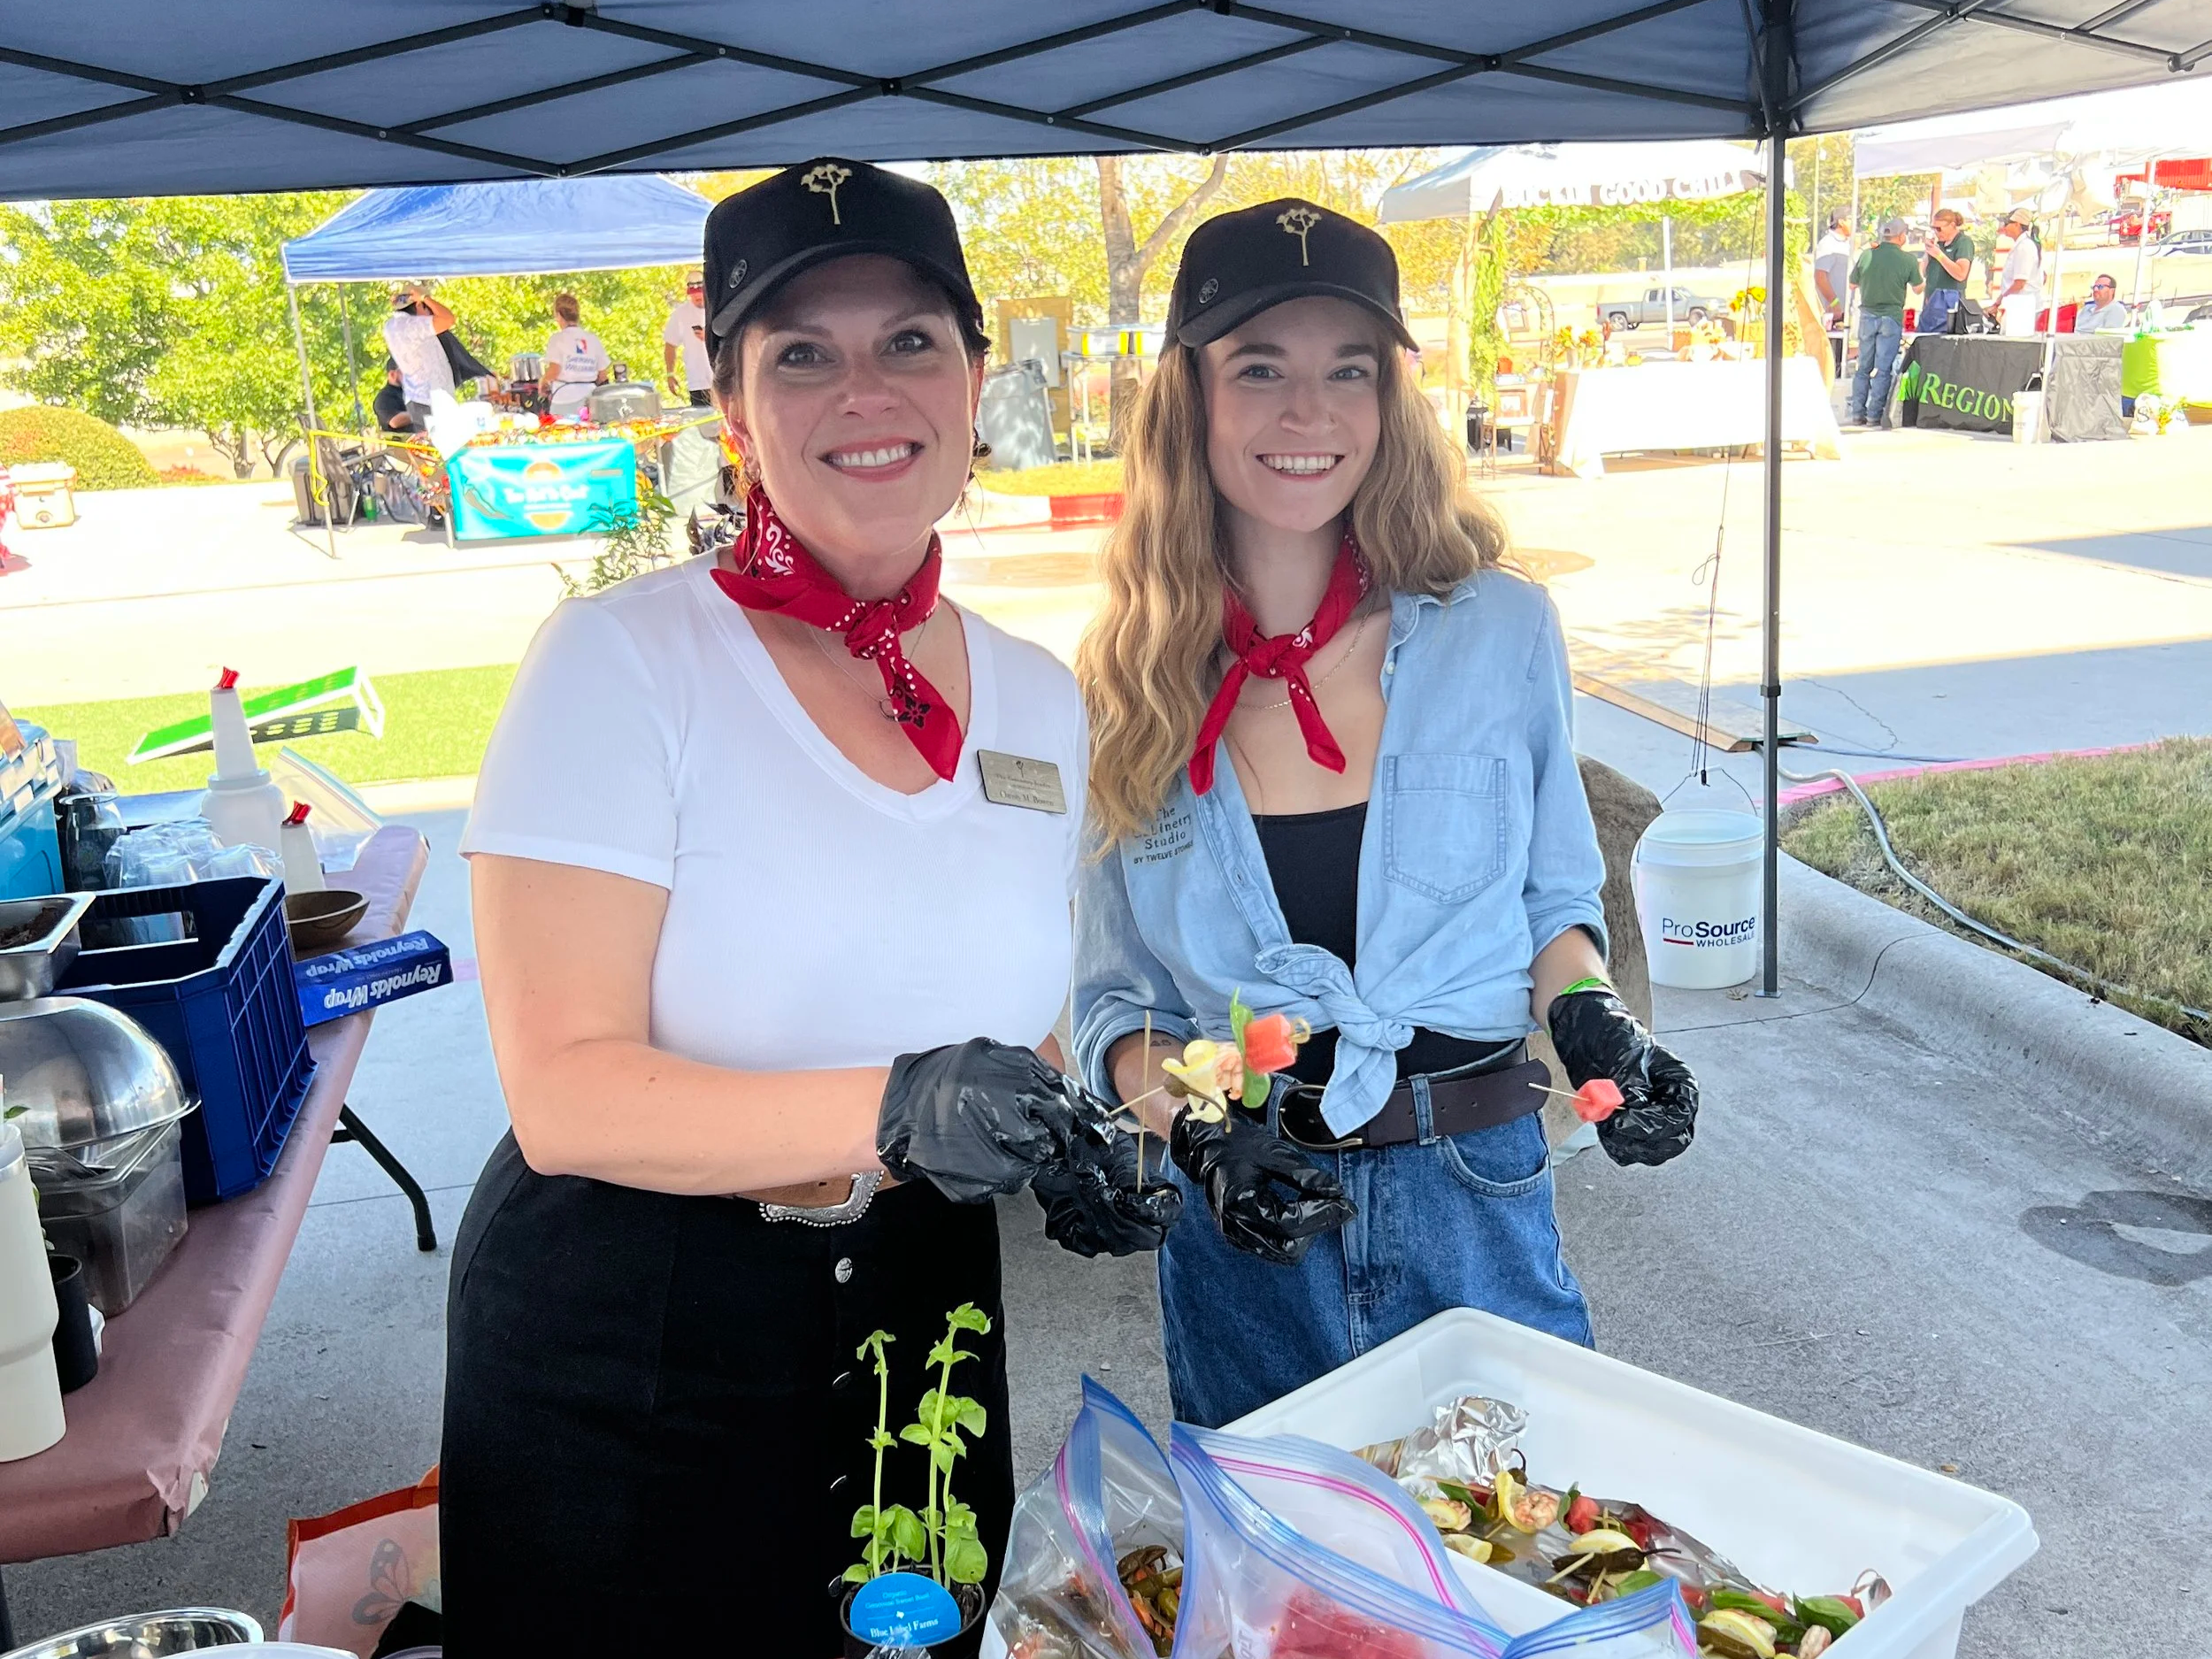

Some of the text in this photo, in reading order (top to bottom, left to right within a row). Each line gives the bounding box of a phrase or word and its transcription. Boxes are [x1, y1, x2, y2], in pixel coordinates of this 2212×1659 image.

[1600, 179, 1667, 205] GOOD
[1145, 830, 1187, 850] Studio
[1147, 849, 1173, 863] TWELVE
[1663, 917, 1755, 938] ProSource
[1696, 930, 1755, 948] WHOLESALE
[354, 938, 429, 965] Reynolds
[306, 955, 355, 977] Wrap
[370, 964, 442, 999] Reynolds
[324, 984, 368, 1009] Wrap
[870, 1626, 888, 1638] Blue
[913, 1618, 939, 1630] Farms
